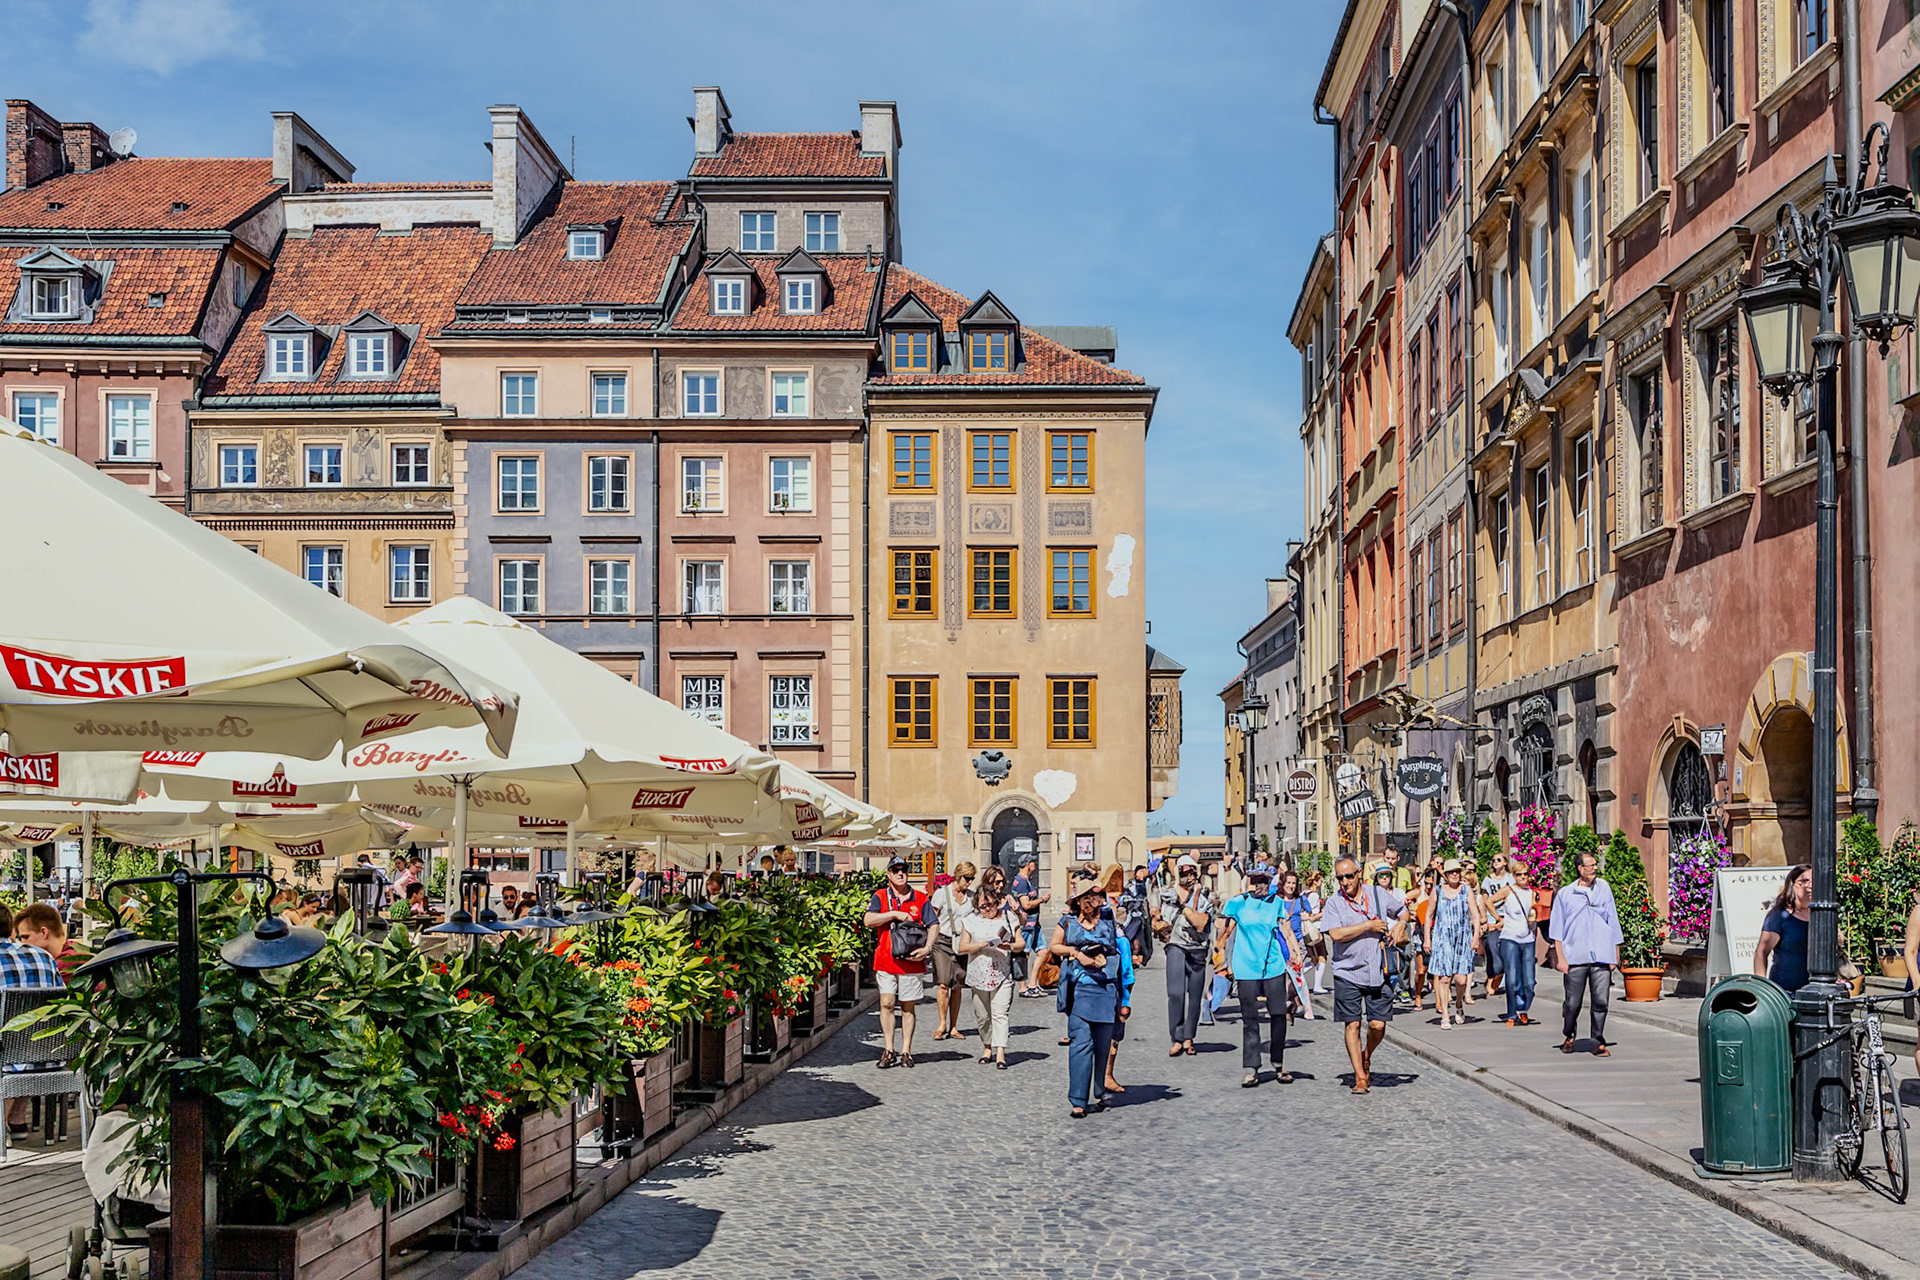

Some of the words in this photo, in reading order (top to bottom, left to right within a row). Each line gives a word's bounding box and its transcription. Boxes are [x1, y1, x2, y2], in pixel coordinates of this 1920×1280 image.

[14, 652, 173, 697] TYSKIE
[1704, 732, 1720, 744] 57
[0, 756, 54, 783] YSKIE
[1289, 777, 1315, 791] BISTRO
[1344, 797, 1374, 817] ANTYKI
